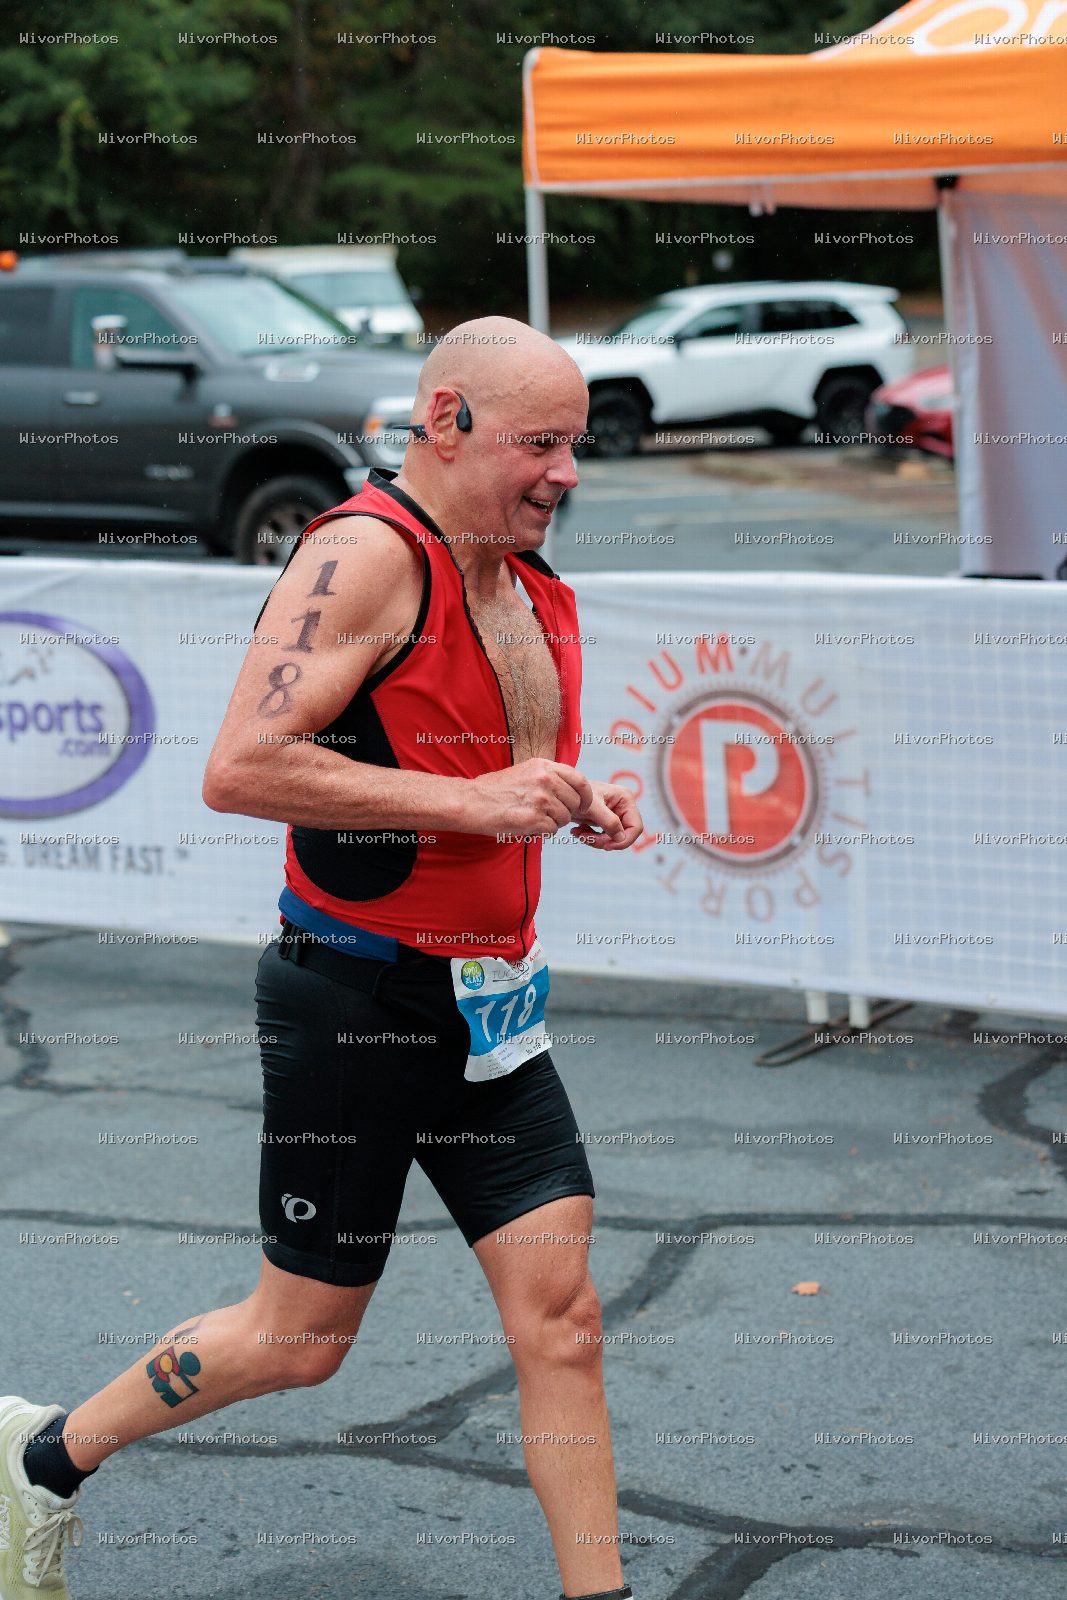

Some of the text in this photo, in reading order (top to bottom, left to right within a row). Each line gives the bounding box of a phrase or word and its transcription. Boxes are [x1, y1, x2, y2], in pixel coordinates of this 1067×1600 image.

[257, 560, 339, 719] 118
[0, 697, 105, 743] ports
[23, 840, 100, 871] DREAM
[475, 983, 537, 1042] 118
